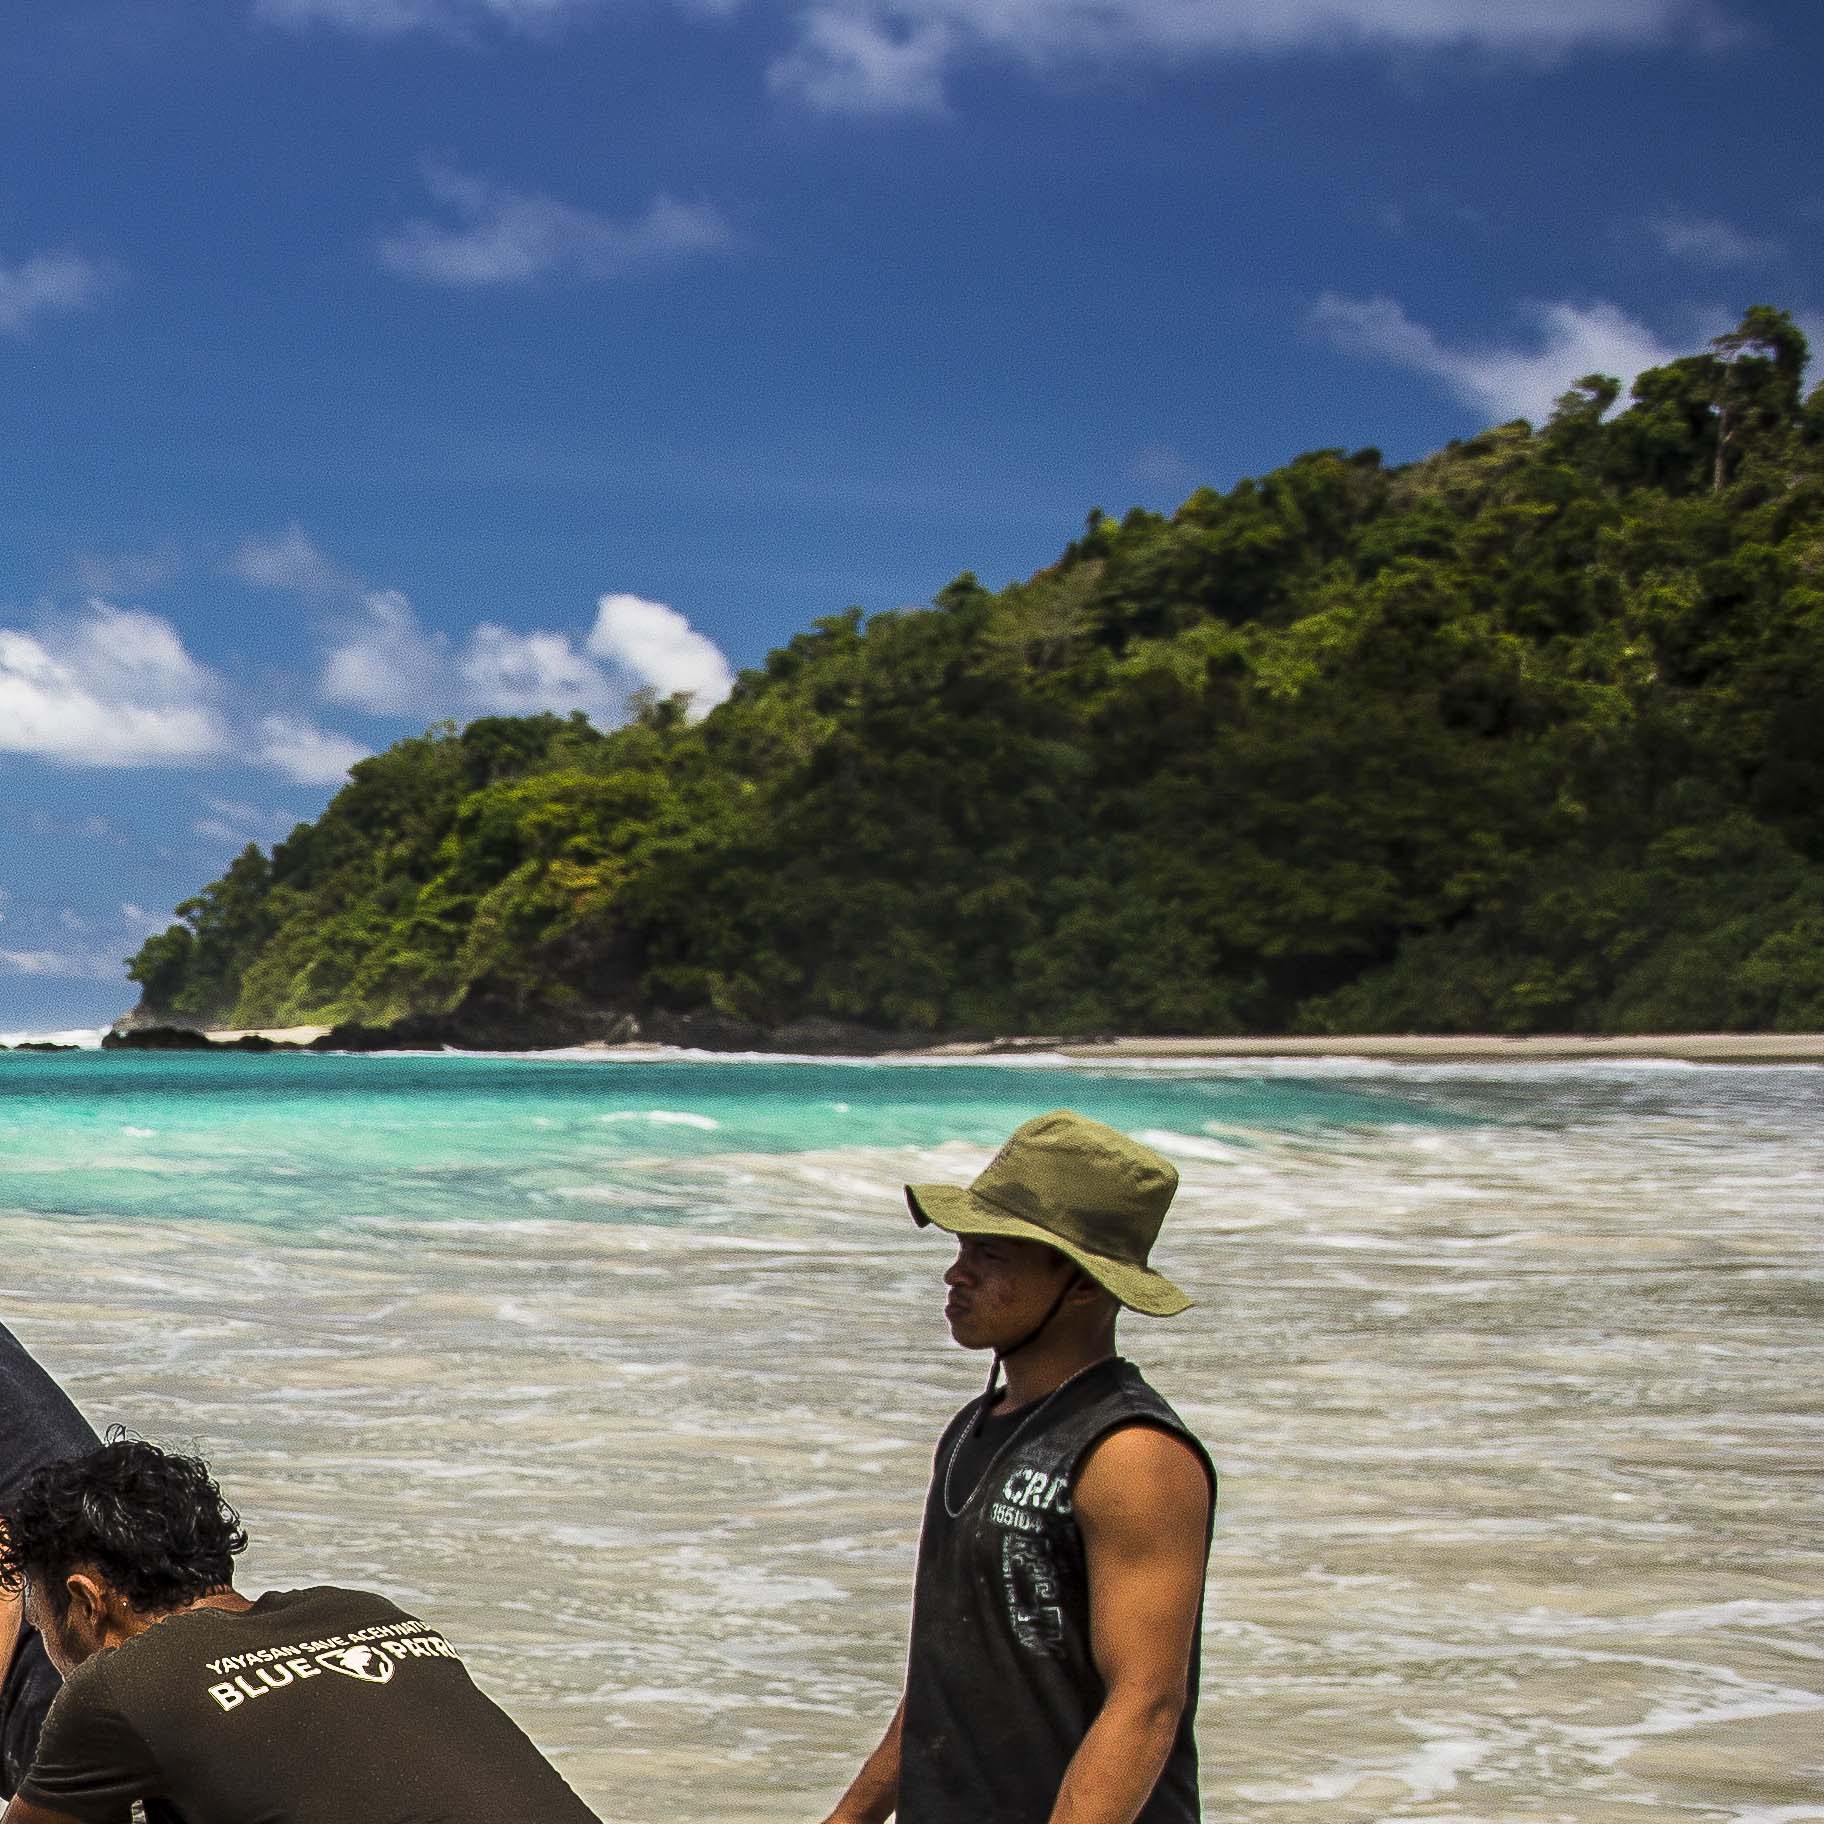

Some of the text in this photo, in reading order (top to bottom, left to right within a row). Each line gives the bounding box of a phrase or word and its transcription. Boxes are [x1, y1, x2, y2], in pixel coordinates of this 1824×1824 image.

[206, 1645, 301, 1675] YAYASAN
[299, 1636, 349, 1654] SAVE
[347, 1625, 397, 1643] ACEH
[208, 1658, 322, 1712] BLUE
